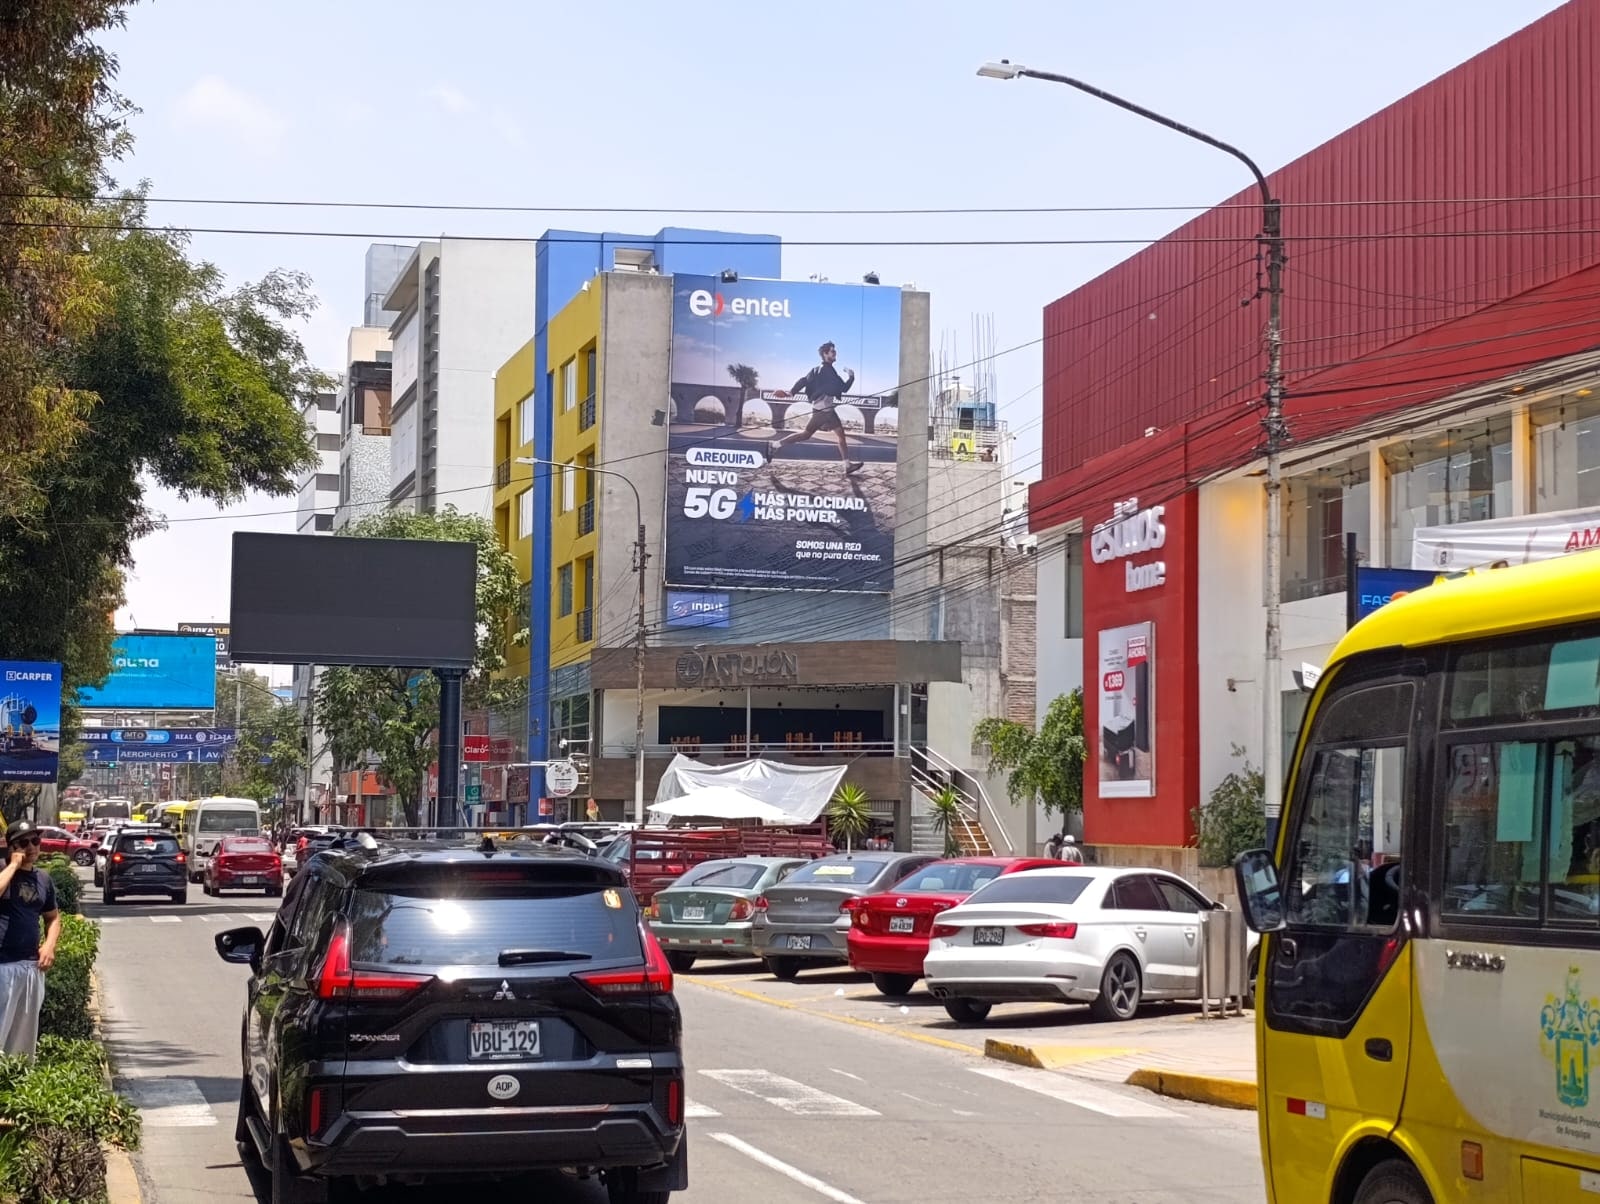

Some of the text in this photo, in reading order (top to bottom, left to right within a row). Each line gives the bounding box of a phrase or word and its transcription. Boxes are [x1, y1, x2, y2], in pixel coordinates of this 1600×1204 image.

[731, 297, 791, 317] entel
[694, 451, 755, 465] AREQUIPA
[686, 469, 738, 485] NUEVO
[683, 488, 738, 520] 5G
[754, 491, 868, 512] MÁS VELOCIDAD,
[754, 505, 840, 523] MÁS POWER.
[796, 540, 862, 551] SOMOS UNA RED
[796, 551, 881, 561] que no para de crecer.
[16, 672, 52, 681] CARPER
[120, 751, 178, 759] AEROPUERTO
[465, 745, 487, 754] Claro
[471, 1030, 537, 1053] VBU-129
[495, 1082, 513, 1092] AQP
